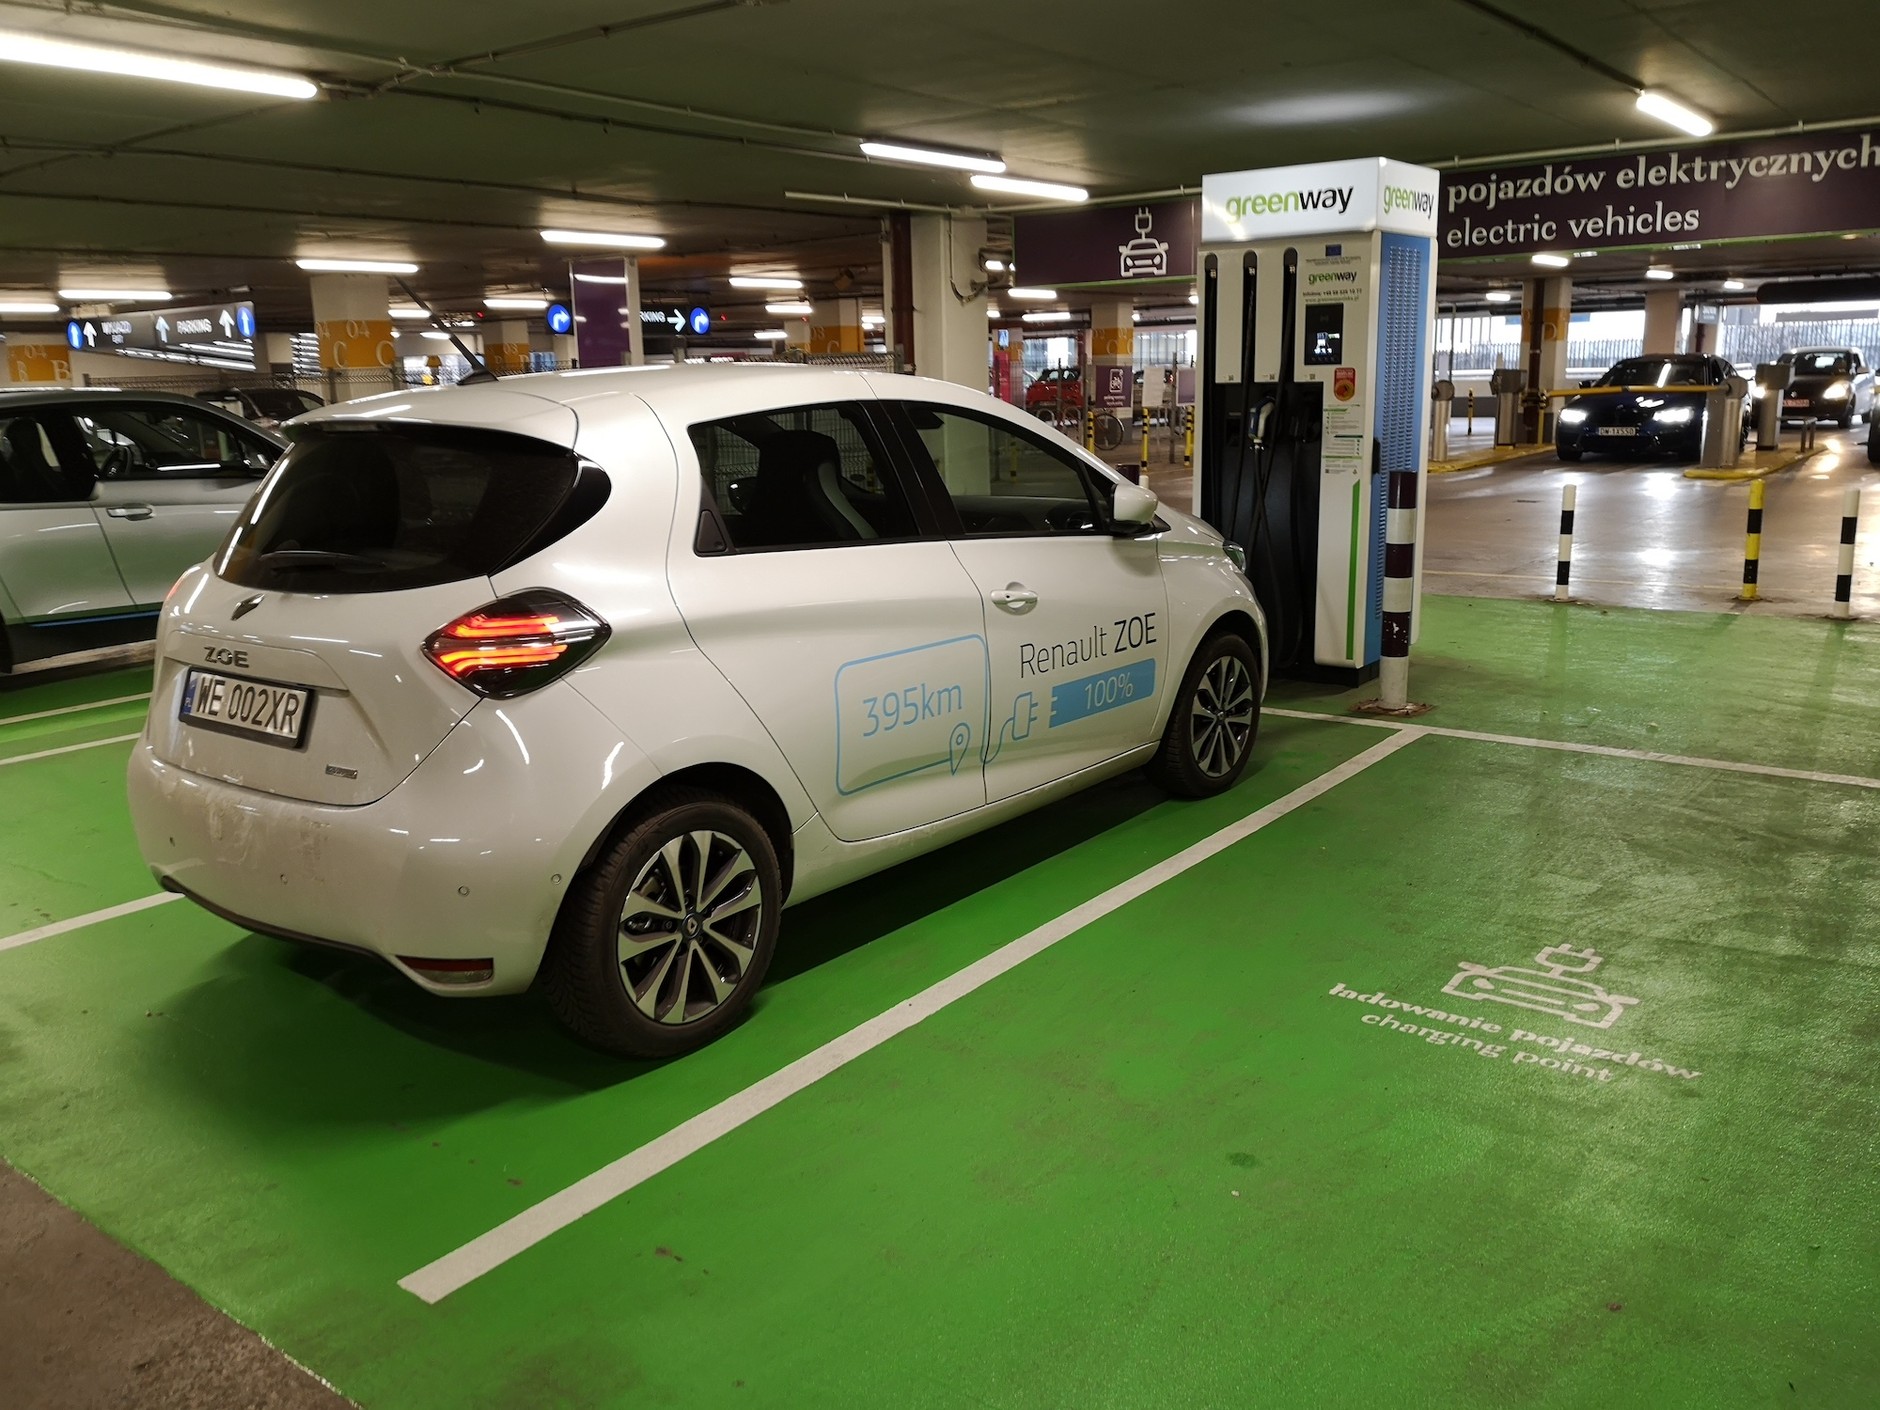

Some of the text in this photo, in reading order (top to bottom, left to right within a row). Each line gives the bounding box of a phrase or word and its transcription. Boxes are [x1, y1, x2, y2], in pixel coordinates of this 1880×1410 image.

[1448, 134, 1880, 213] pojazdów elektrycznych
[1226, 186, 1354, 224] greenway
[1384, 185, 1434, 219] greenway
[1447, 201, 1700, 248] electric vehicles
[1308, 271, 1357, 285] greenway
[176, 318, 213, 334] PARKING
[346, 320, 370, 338] 04
[50, 360, 71, 382] B
[333, 340, 347, 368] C
[376, 340, 396, 368] C
[204, 646, 249, 668] ZOE
[1019, 612, 1157, 679] Renault ZOE
[196, 676, 300, 733] WE 002XR
[862, 682, 963, 738] 395km
[1084, 672, 1134, 710] 100%
[1328, 982, 1702, 1080] ładowanie pojazdów
[1360, 1012, 1614, 1083] charging point
